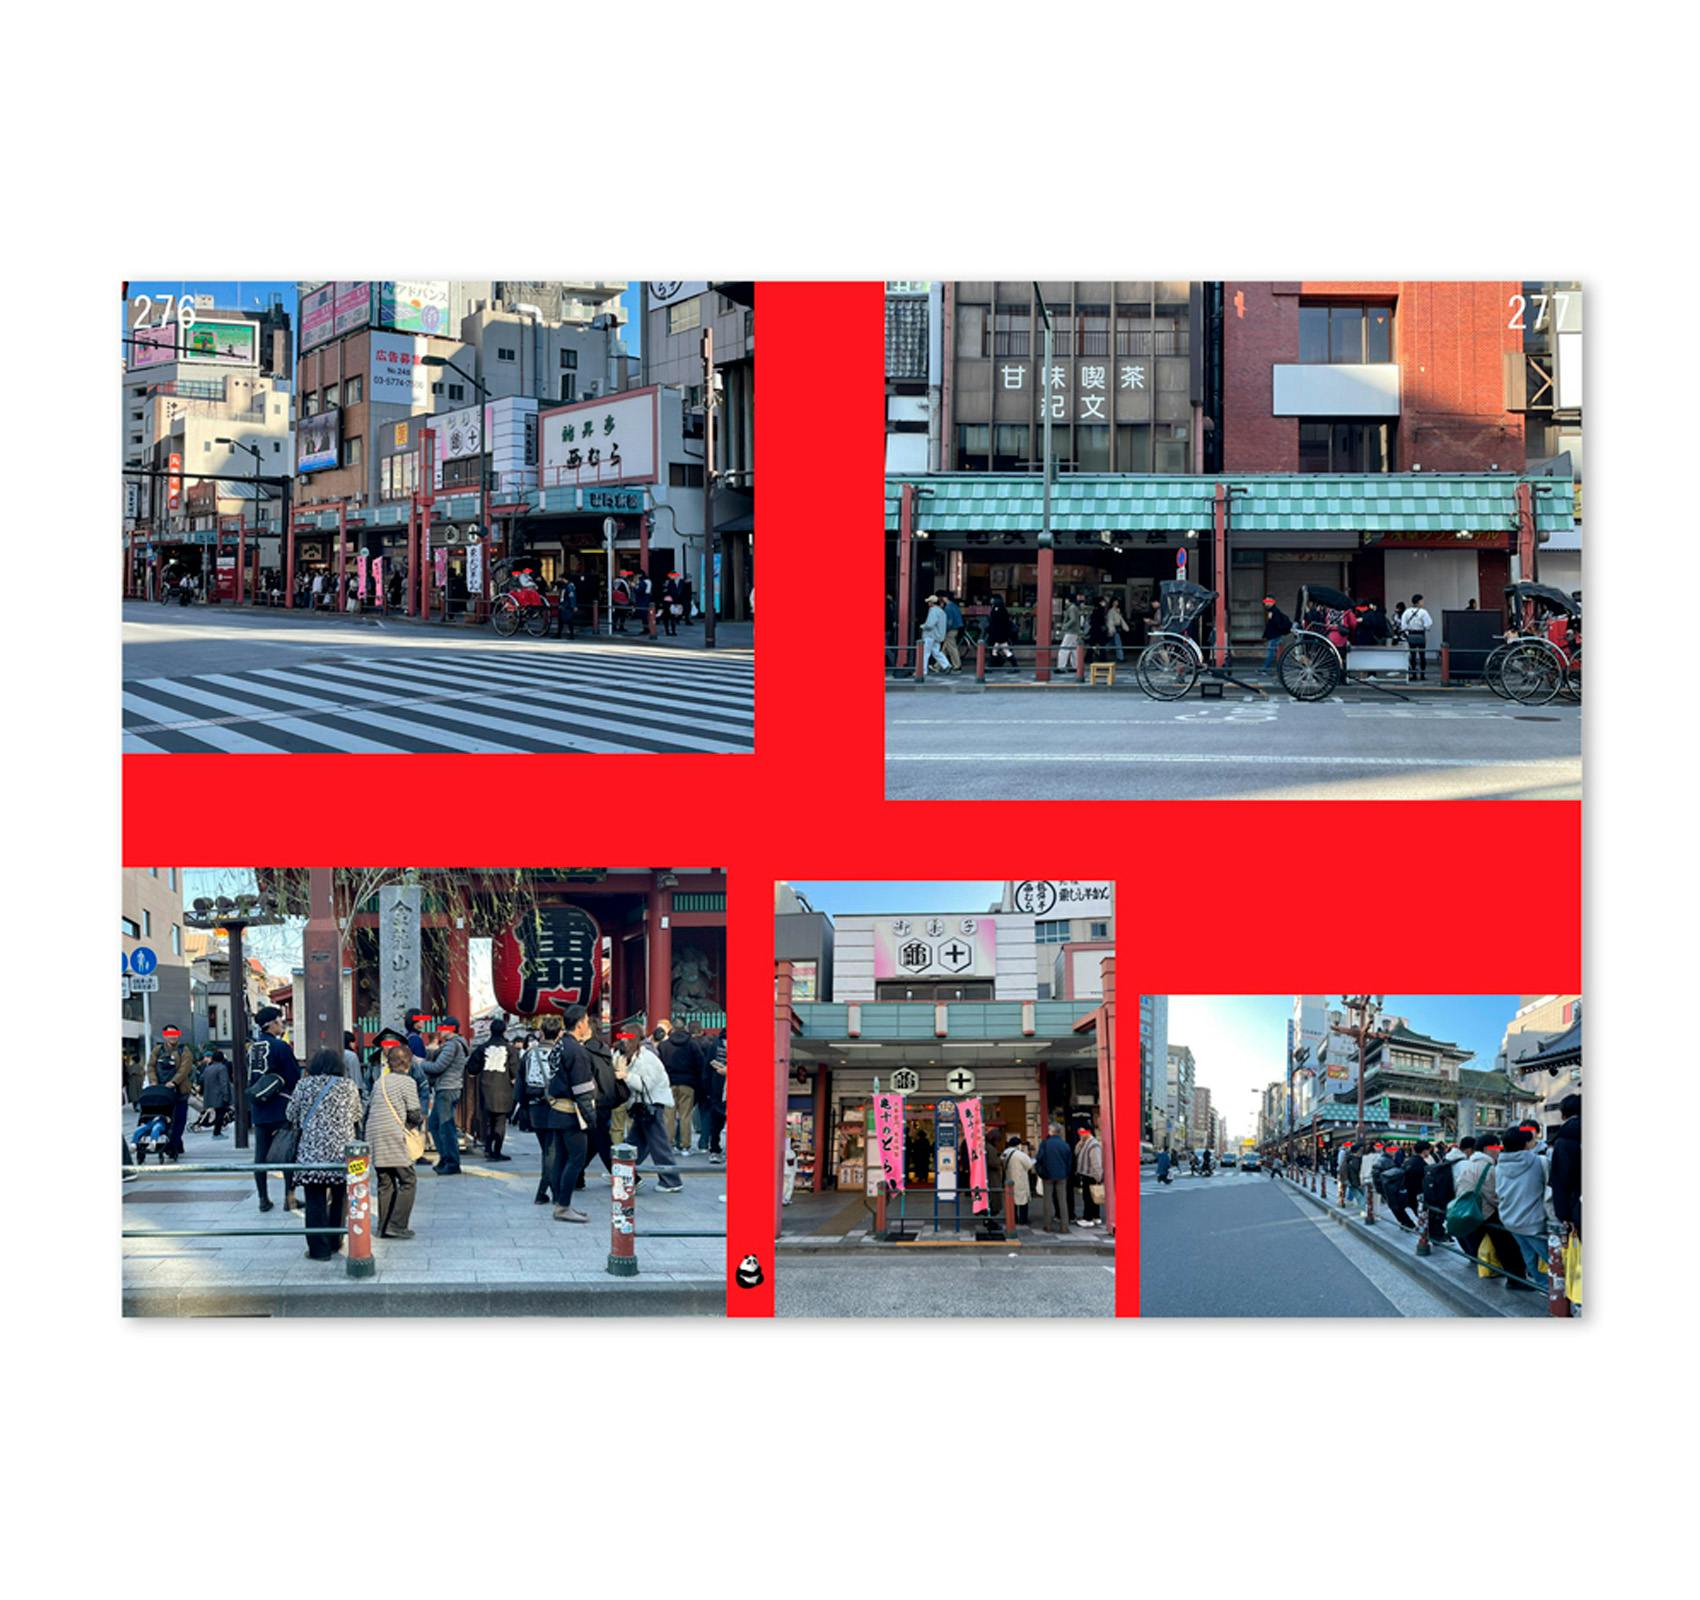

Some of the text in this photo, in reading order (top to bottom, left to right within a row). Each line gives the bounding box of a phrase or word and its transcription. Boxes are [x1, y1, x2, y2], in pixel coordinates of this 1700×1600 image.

[1001, 365, 1145, 389] 甘味喫茶
[512, 905, 599, 1013] 雷門
